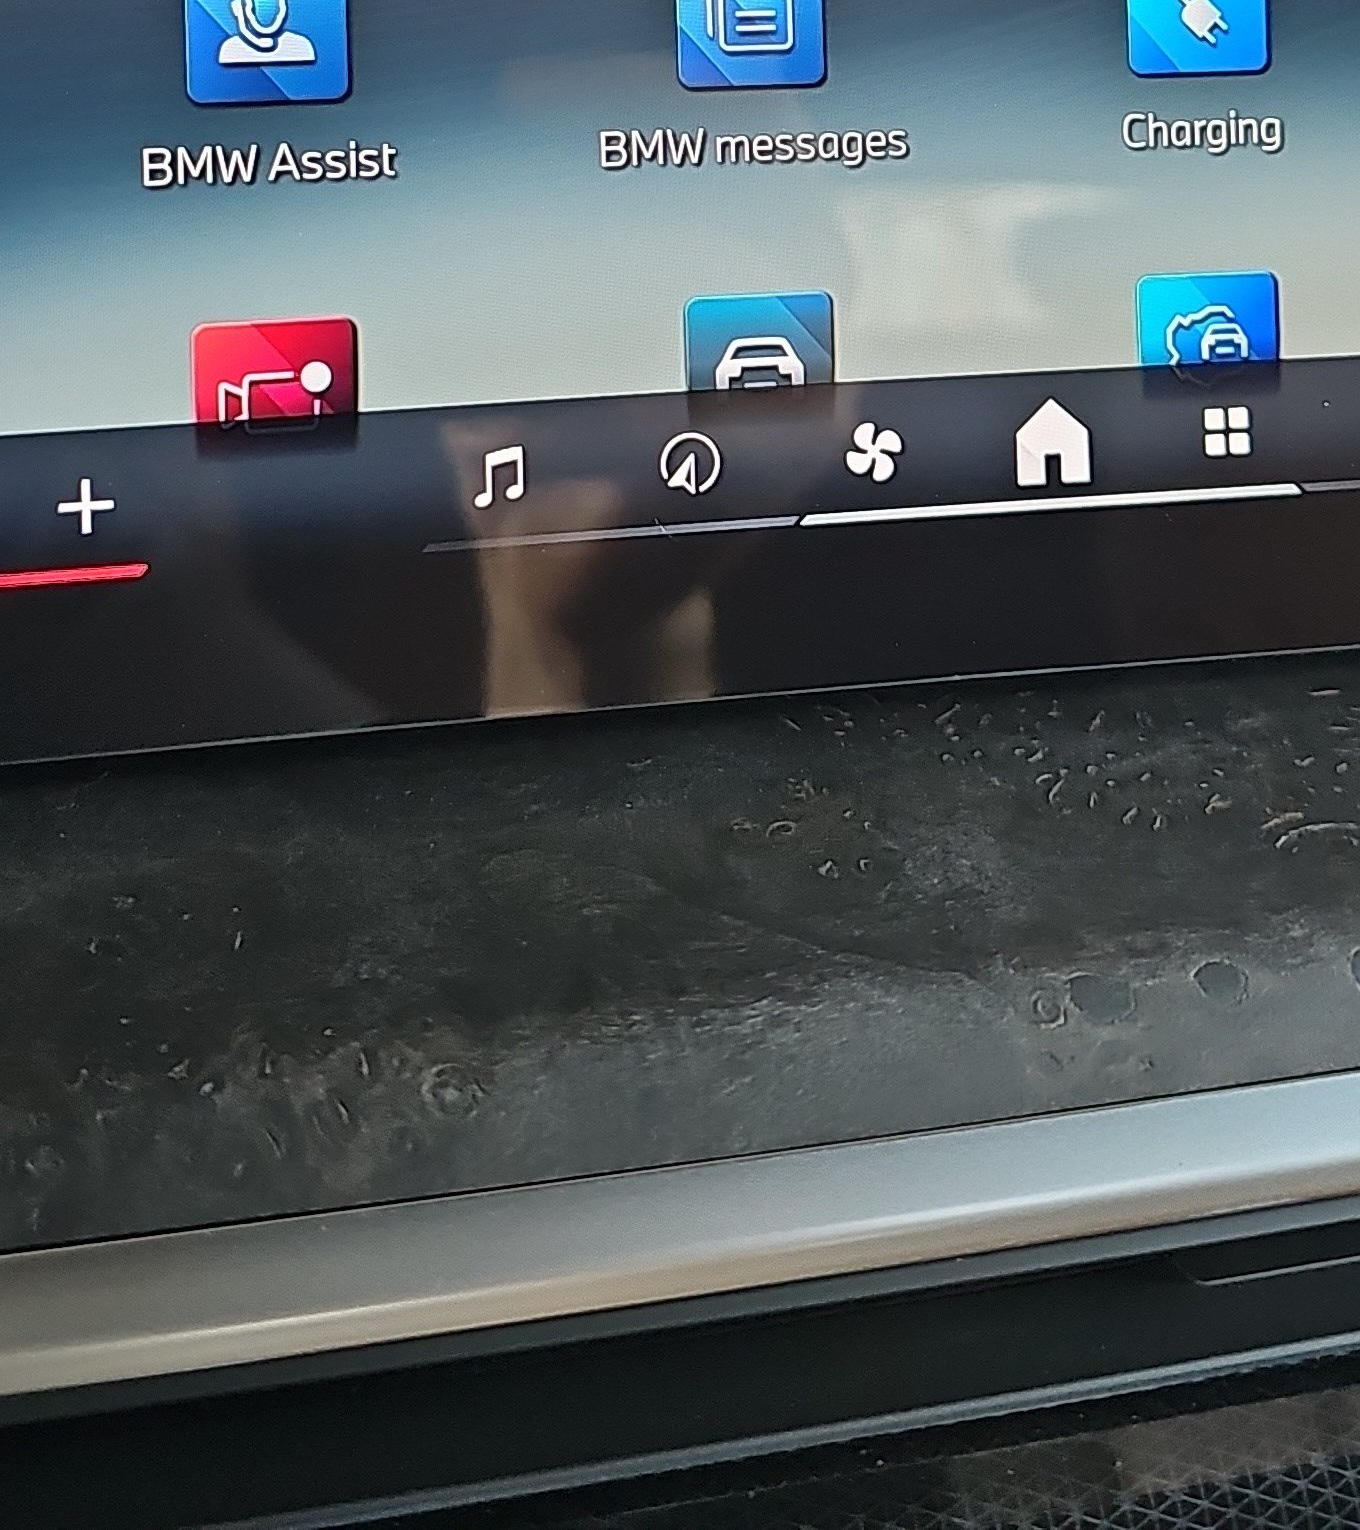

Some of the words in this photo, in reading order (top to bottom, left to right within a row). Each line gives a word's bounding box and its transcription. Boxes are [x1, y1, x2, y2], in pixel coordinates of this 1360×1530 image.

[598, 128, 705, 170] BMW
[714, 127, 909, 167] messages
[1121, 111, 1284, 155] Charging
[140, 145, 259, 187] BMW
[268, 140, 398, 183] Assist
